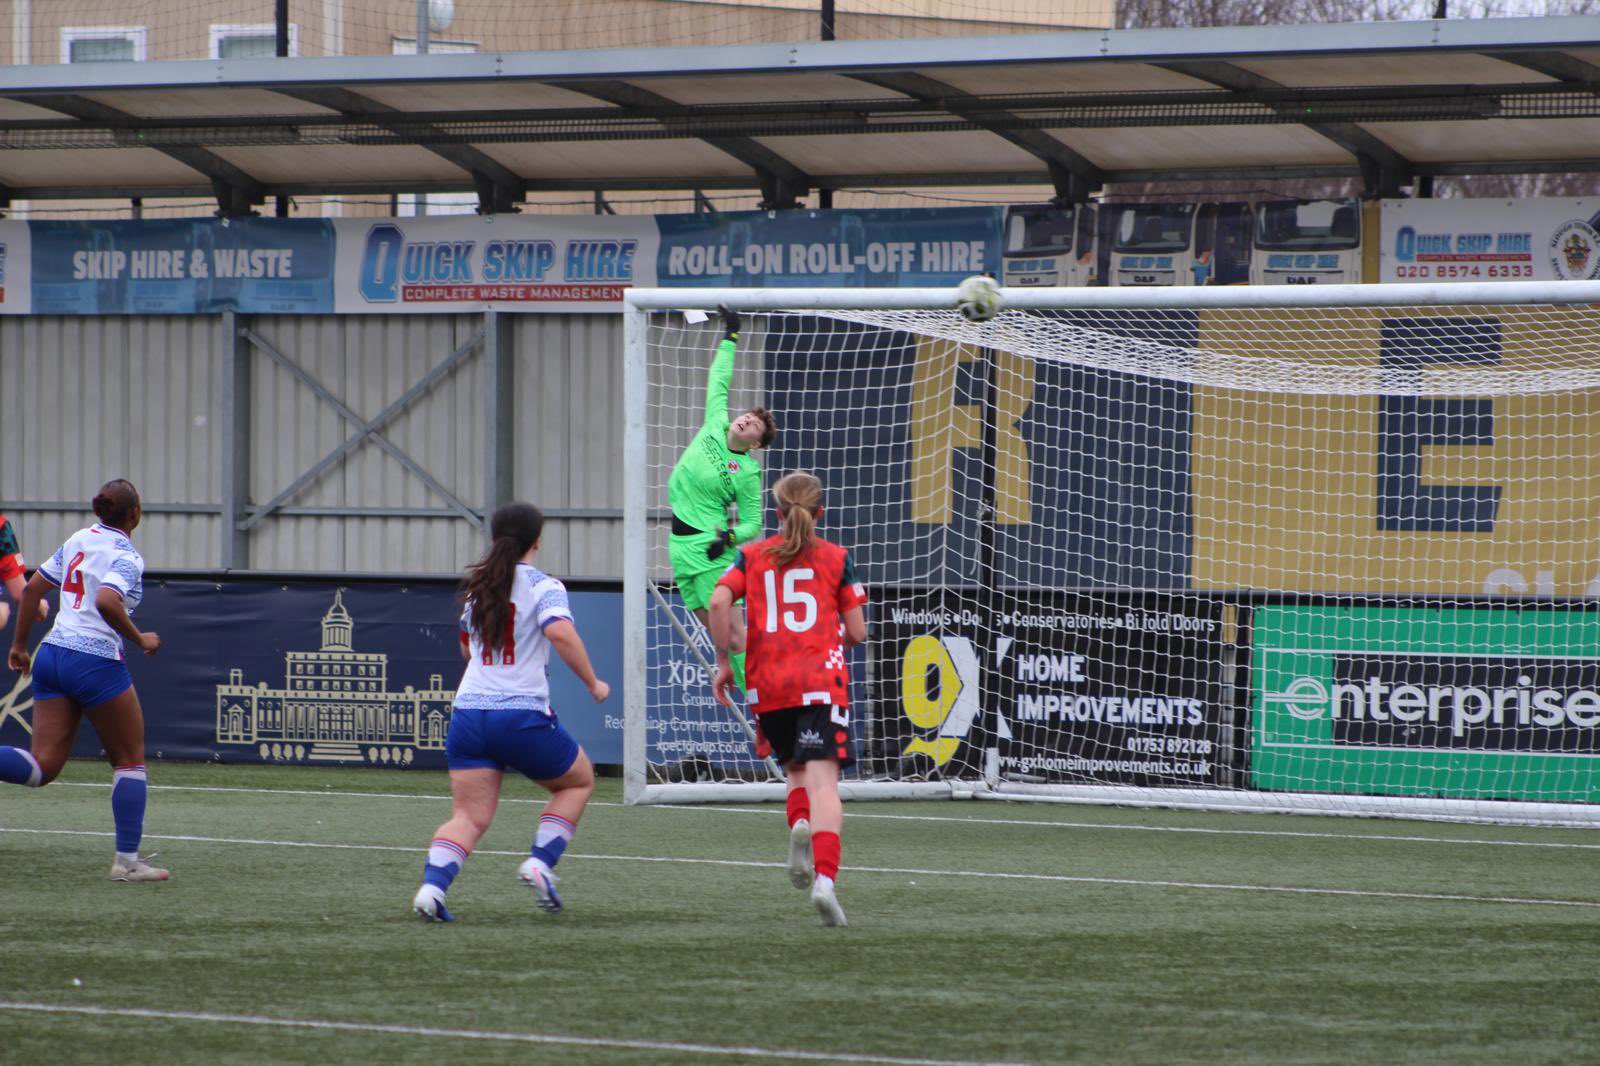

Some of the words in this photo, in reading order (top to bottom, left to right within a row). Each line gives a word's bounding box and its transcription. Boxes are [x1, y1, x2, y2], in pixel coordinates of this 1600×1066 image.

[668, 243, 783, 276] ROLL-ON
[789, 241, 915, 275] ROLL-OFF
[921, 240, 985, 273] HIRE
[1395, 224, 1453, 263] QUICK
[1456, 233, 1492, 253] SKIP
[1496, 231, 1532, 253] HIRE
[72, 250, 126, 280] SKIP
[131, 250, 184, 279] HIRE
[189, 251, 208, 279] &
[214, 249, 294, 278] WASTE
[359, 223, 475, 303] QUICK
[482, 239, 556, 283] SKIP
[564, 238, 638, 282] HIRE
[1396, 265, 1429, 278] 020
[1436, 265, 1481, 278] 8574
[1488, 265, 1533, 277] 6333
[405, 287, 475, 301] COMPLETE
[480, 287, 525, 300] WASTE
[62, 551, 86, 610] 4
[763, 567, 818, 634] 15
[891, 607, 952, 627] Windows
[1012, 610, 1115, 630] Conservatories
[1141, 613, 1170, 631] fold
[1174, 614, 1216, 632] Doors
[1017, 654, 1086, 682] HOME
[682, 692, 716, 710] Group
[1017, 695, 1204, 726] IMPROVEMENTS
[1283, 675, 1600, 737] enterprise
[1127, 737, 1165, 753] 01753
[998, 754, 1212, 777] ww.gxhomeimprovements.co.uk
